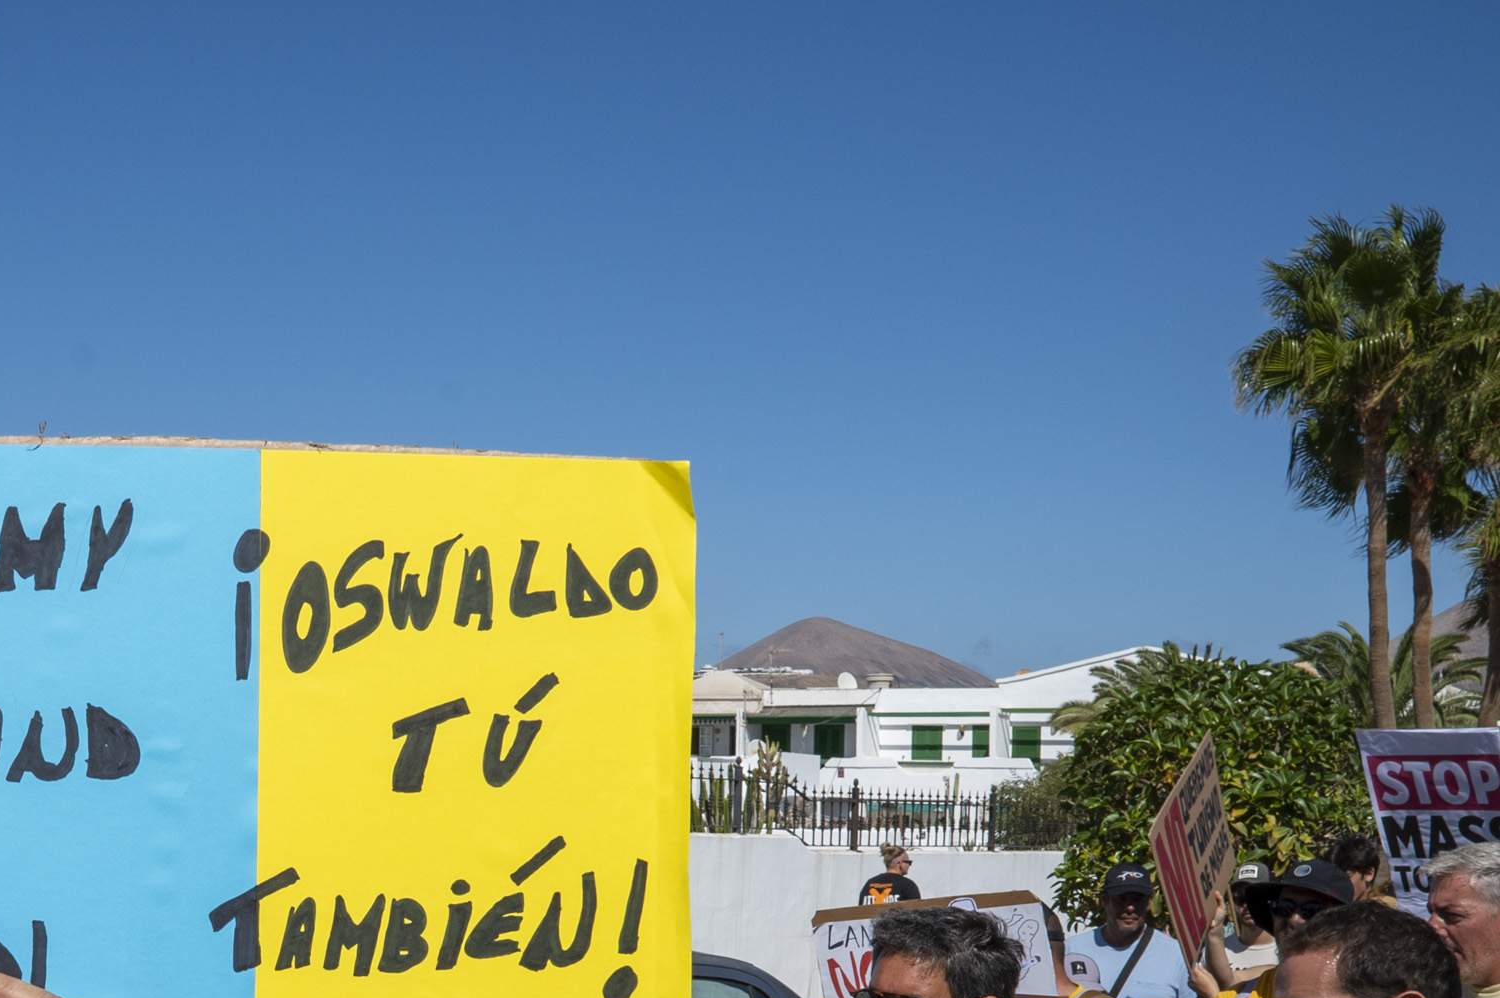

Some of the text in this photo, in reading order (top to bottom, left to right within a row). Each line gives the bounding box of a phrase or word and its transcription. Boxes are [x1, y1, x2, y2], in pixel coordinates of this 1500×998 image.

[392, 672, 559, 793] TÚ
[1376, 760, 1500, 805] STOP
[1394, 866, 1430, 893] TO
[828, 924, 872, 950] LAN
